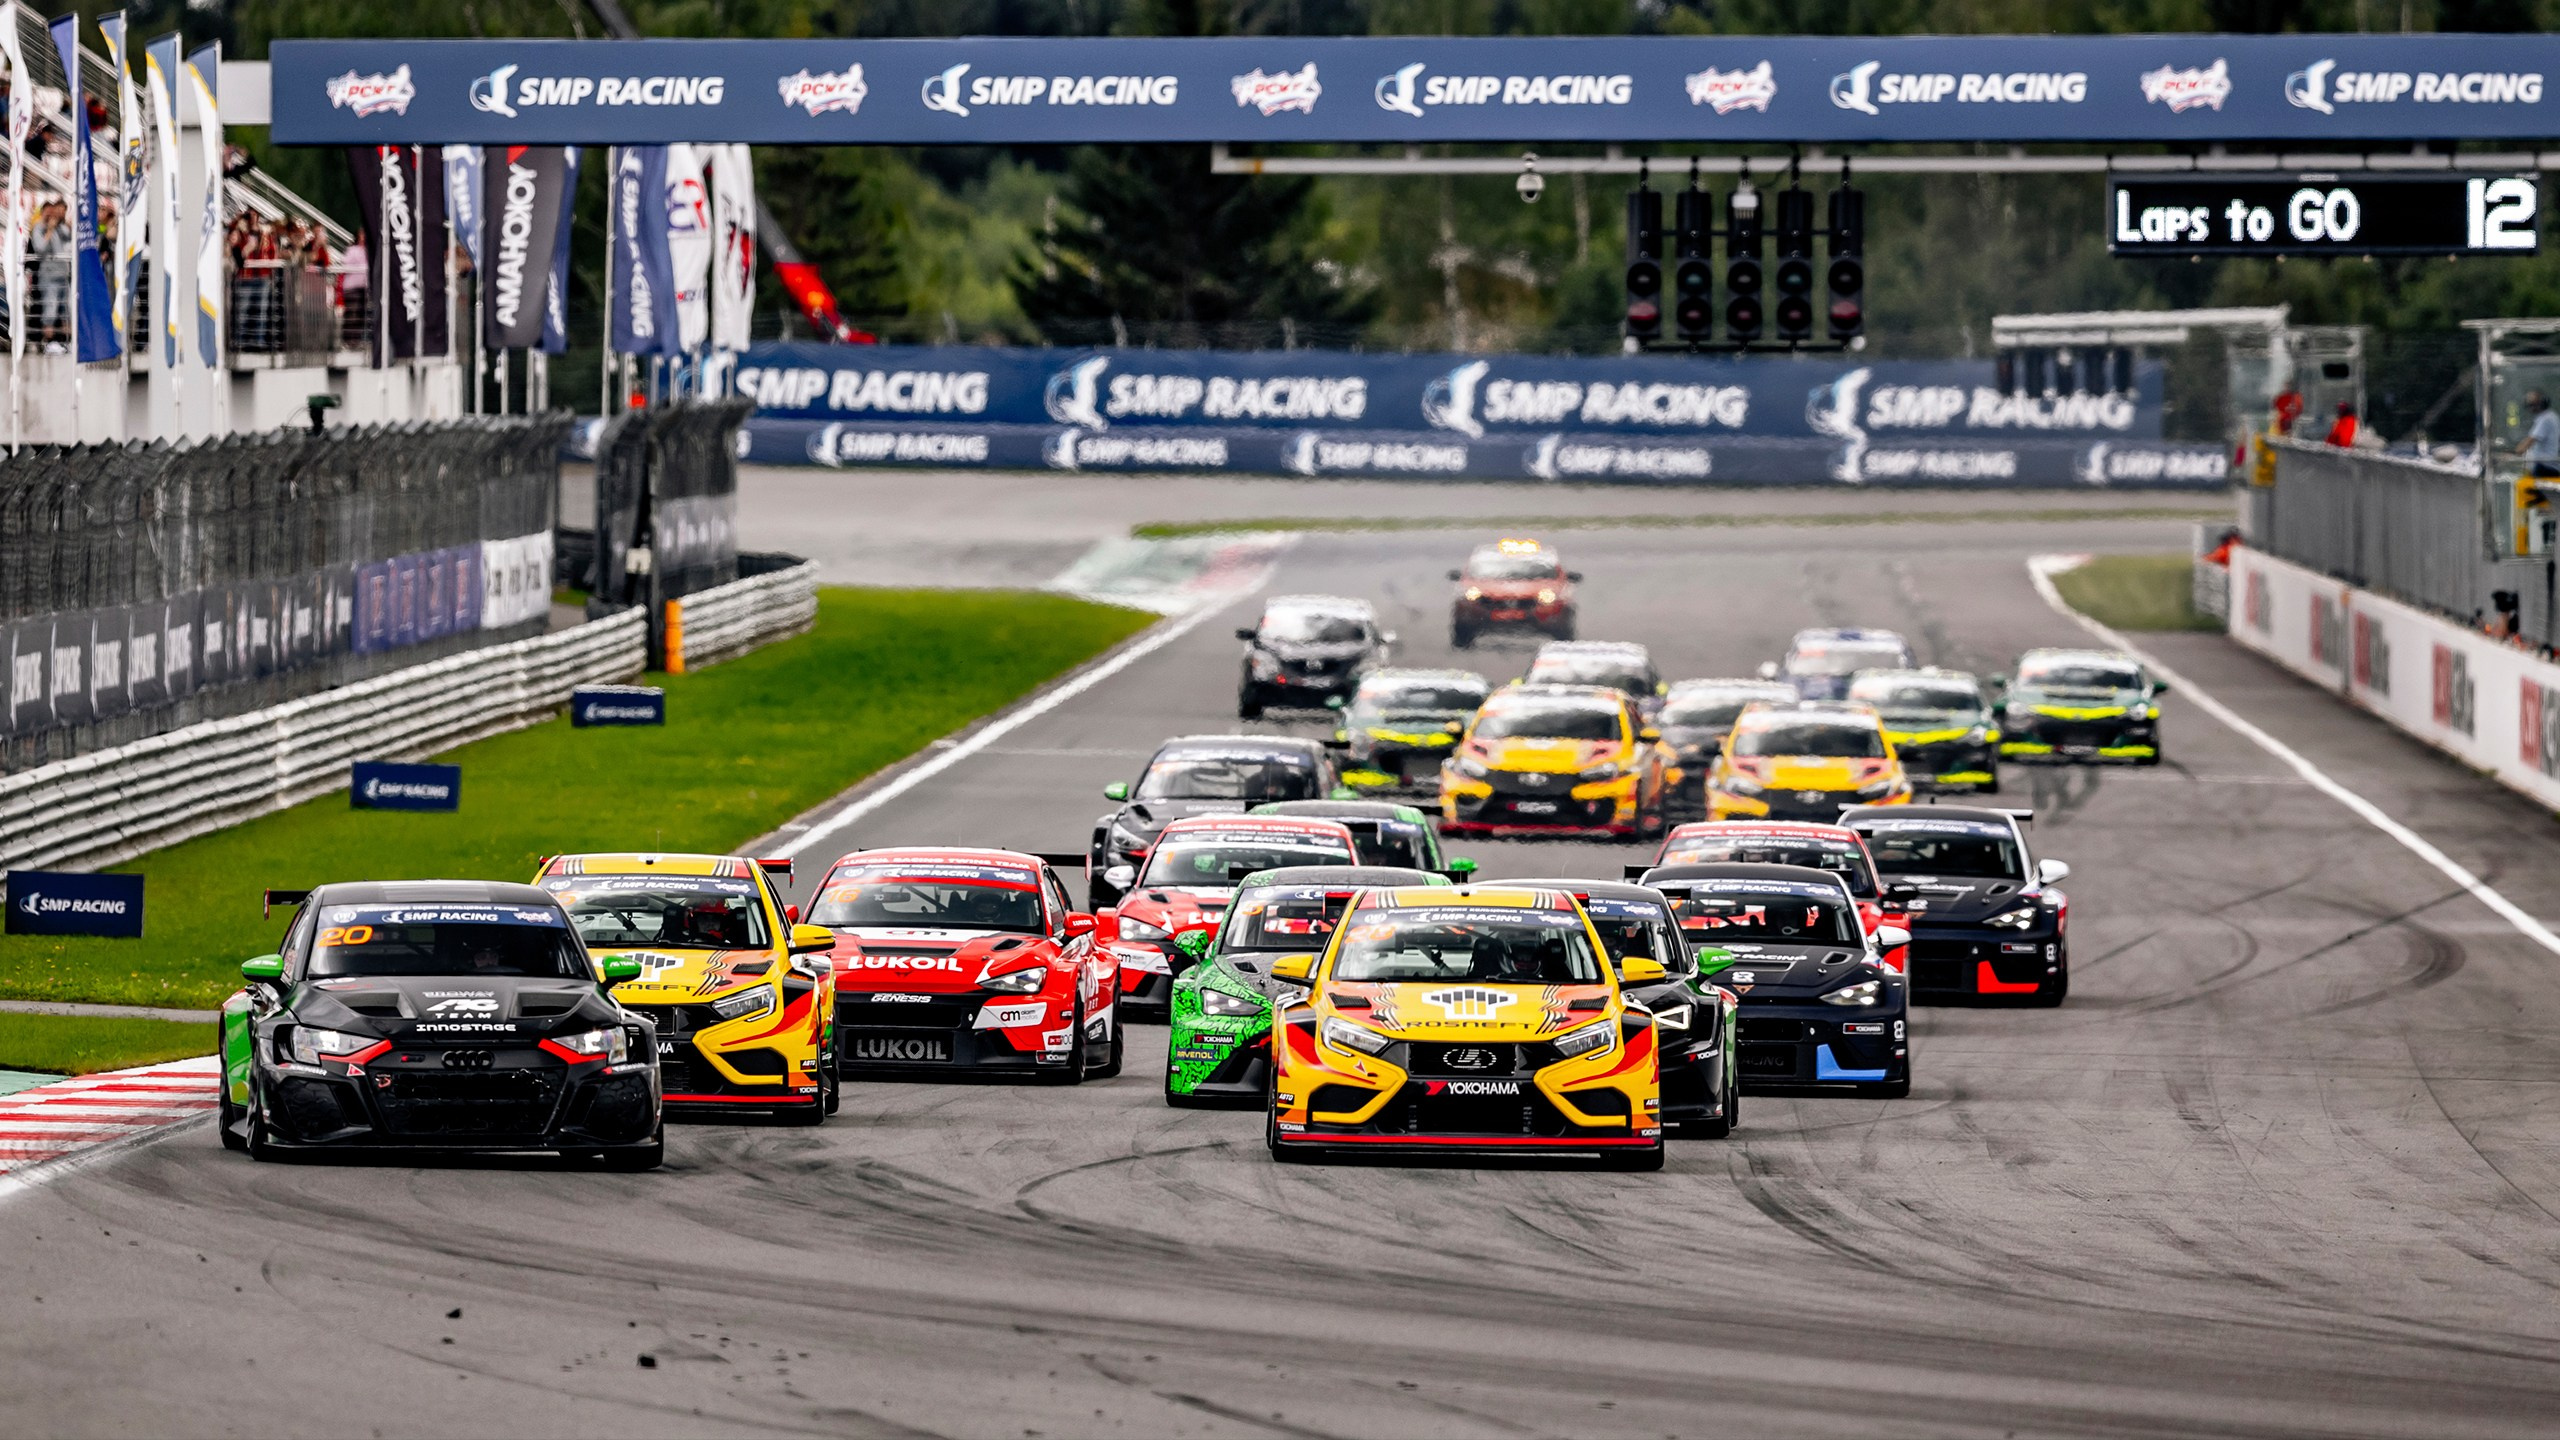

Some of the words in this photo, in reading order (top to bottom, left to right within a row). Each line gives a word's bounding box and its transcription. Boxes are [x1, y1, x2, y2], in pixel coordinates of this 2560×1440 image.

[517, 76, 594, 106] SMP
[596, 77, 725, 106] RACING
[969, 76, 1046, 106] SMP
[1048, 76, 1178, 106] RACING
[1424, 75, 1500, 105] SMP
[1502, 75, 1633, 105] RACING
[1878, 73, 1955, 103] SMP
[1957, 73, 2088, 103] RACING
[2333, 71, 2411, 102] SMP
[2412, 73, 2544, 104] RACING
[2116, 188, 2210, 242] Laps
[2224, 198, 2275, 242] to
[2287, 186, 2361, 242] GO
[2466, 177, 2538, 249] 12
[736, 367, 829, 409] SMP
[828, 370, 989, 413] RACING
[1106, 374, 1203, 418] SMP
[1203, 376, 1368, 420] RACING
[1484, 378, 1583, 423] SMP
[1581, 381, 1749, 428] RACING
[1867, 383, 1966, 429] SMP
[841, 431, 896, 460] SMP
[895, 433, 989, 461] RACING
[1227, 835, 1255, 843] SMP
[1257, 835, 1298, 844] RACING
[901, 869, 931, 877] SMP
[930, 870, 980, 878] RACING
[995, 861, 1030, 870] TEAM
[645, 882, 700, 890] RACING
[1712, 884, 1742, 892] SMP
[1742, 885, 1792, 893] RACING
[40, 897, 72, 912] SMP
[71, 899, 126, 915] RACING
[403, 911, 438, 922] SMP
[439, 912, 499, 922] RACING
[1431, 913, 1465, 922] SMP
[1465, 914, 1522, 923] RACING
[317, 924, 374, 948] 20
[847, 955, 963, 973] LUKOIL
[870, 993, 932, 1003] GENESIS
[1000, 1010, 1020, 1021] am
[1406, 1020, 1535, 1029] ROSNEFT
[1894, 1020, 1905, 1039] 8
[1203, 1035, 1233, 1043] YOKOHAMA
[856, 1038, 947, 1060] LUKOIL
[1177, 1050, 1213, 1059] RAVENOL
[1448, 1082, 1520, 1095] YOKOHAMA
